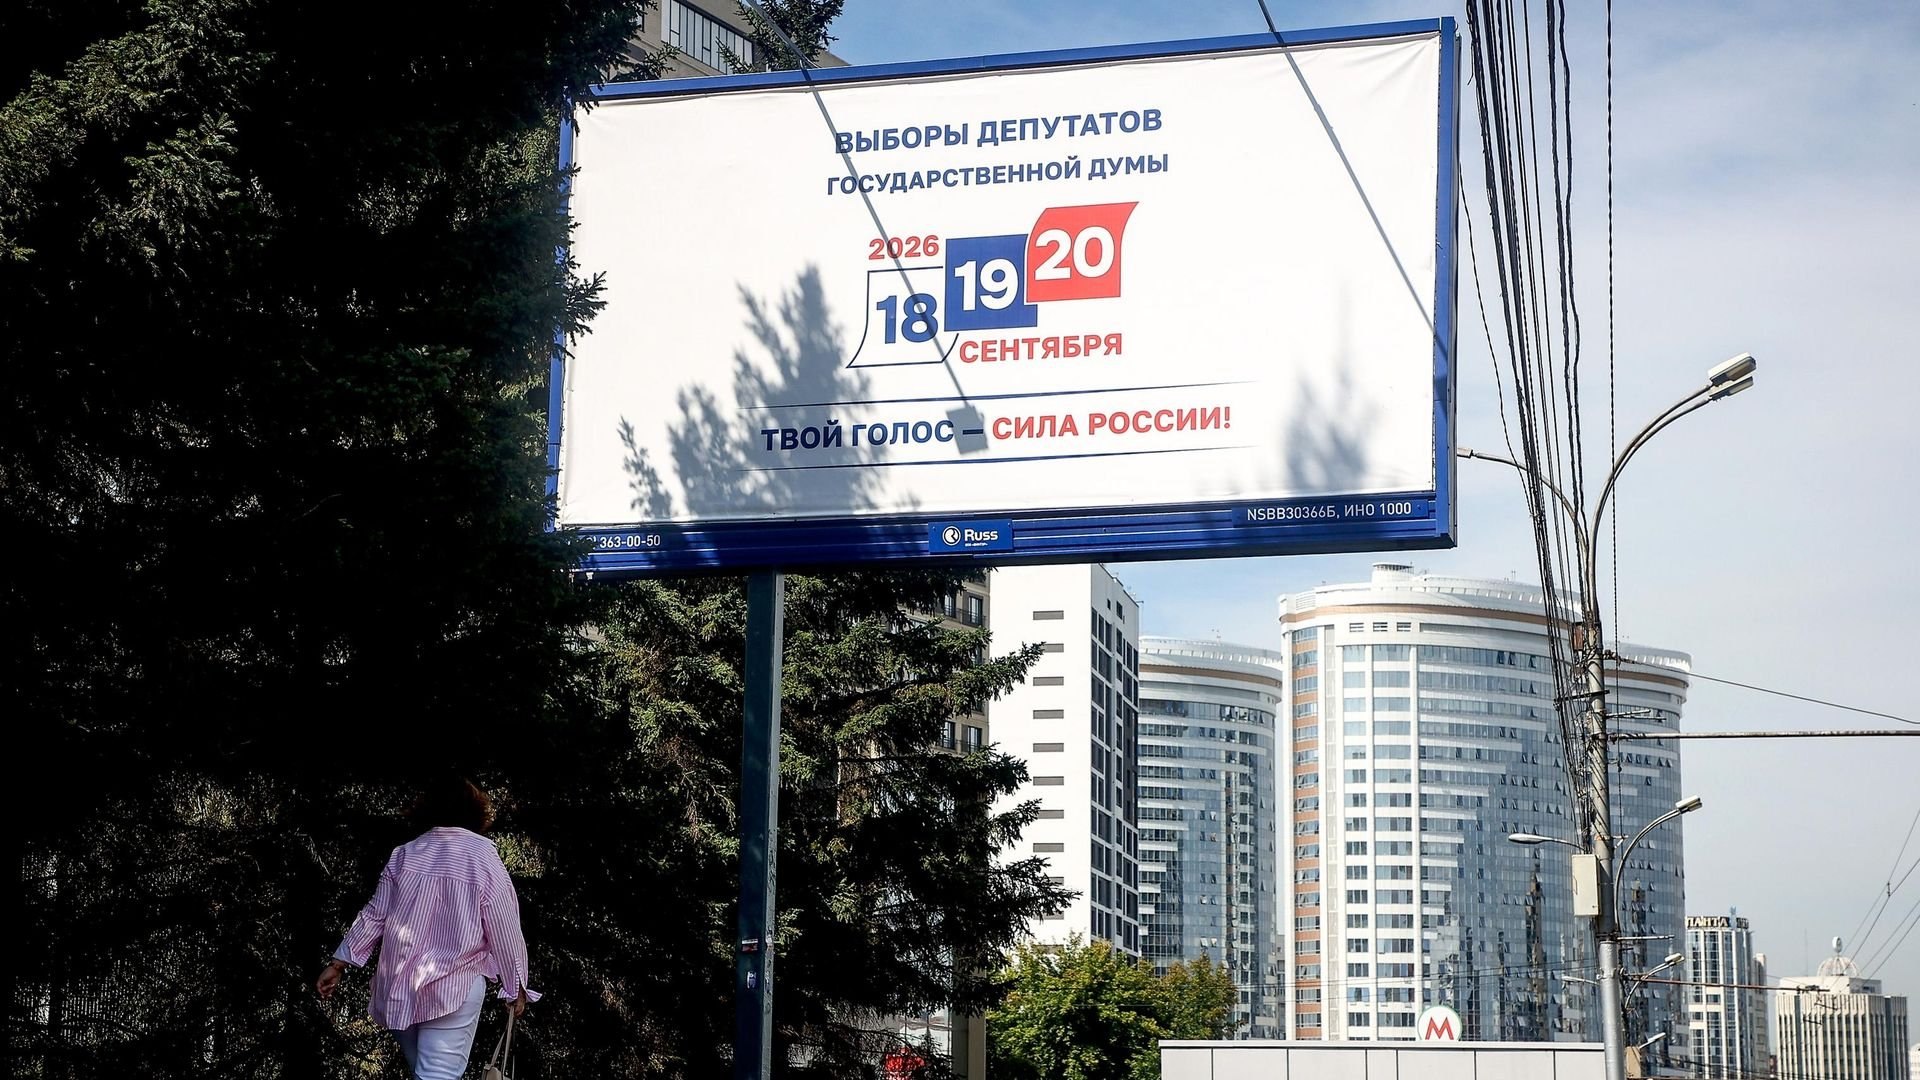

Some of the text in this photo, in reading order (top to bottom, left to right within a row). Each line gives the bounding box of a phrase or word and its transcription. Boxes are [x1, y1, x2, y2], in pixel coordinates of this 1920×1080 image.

[835, 108, 1162, 154] ВЫБОРЫ ДЕПУТАТОВ
[827, 153, 1169, 195] ГОСУДАРСТВЕННОЙ ДУМЫ
[868, 235, 940, 260] 2026
[876, 226, 1115, 344] 18 19 20
[959, 333, 1122, 364] СЕНТЯБРЯ
[760, 419, 842, 451] ТВОЙ
[851, 420, 954, 447] ГОЛОС
[992, 413, 1079, 440] СИЛА
[1089, 406, 1232, 436] РОССИИ!
[1344, 504, 1375, 517] ИНО
[1380, 502, 1412, 516] 1000
[599, 534, 661, 548] 363-00-50
[964, 528, 998, 542] Russ
